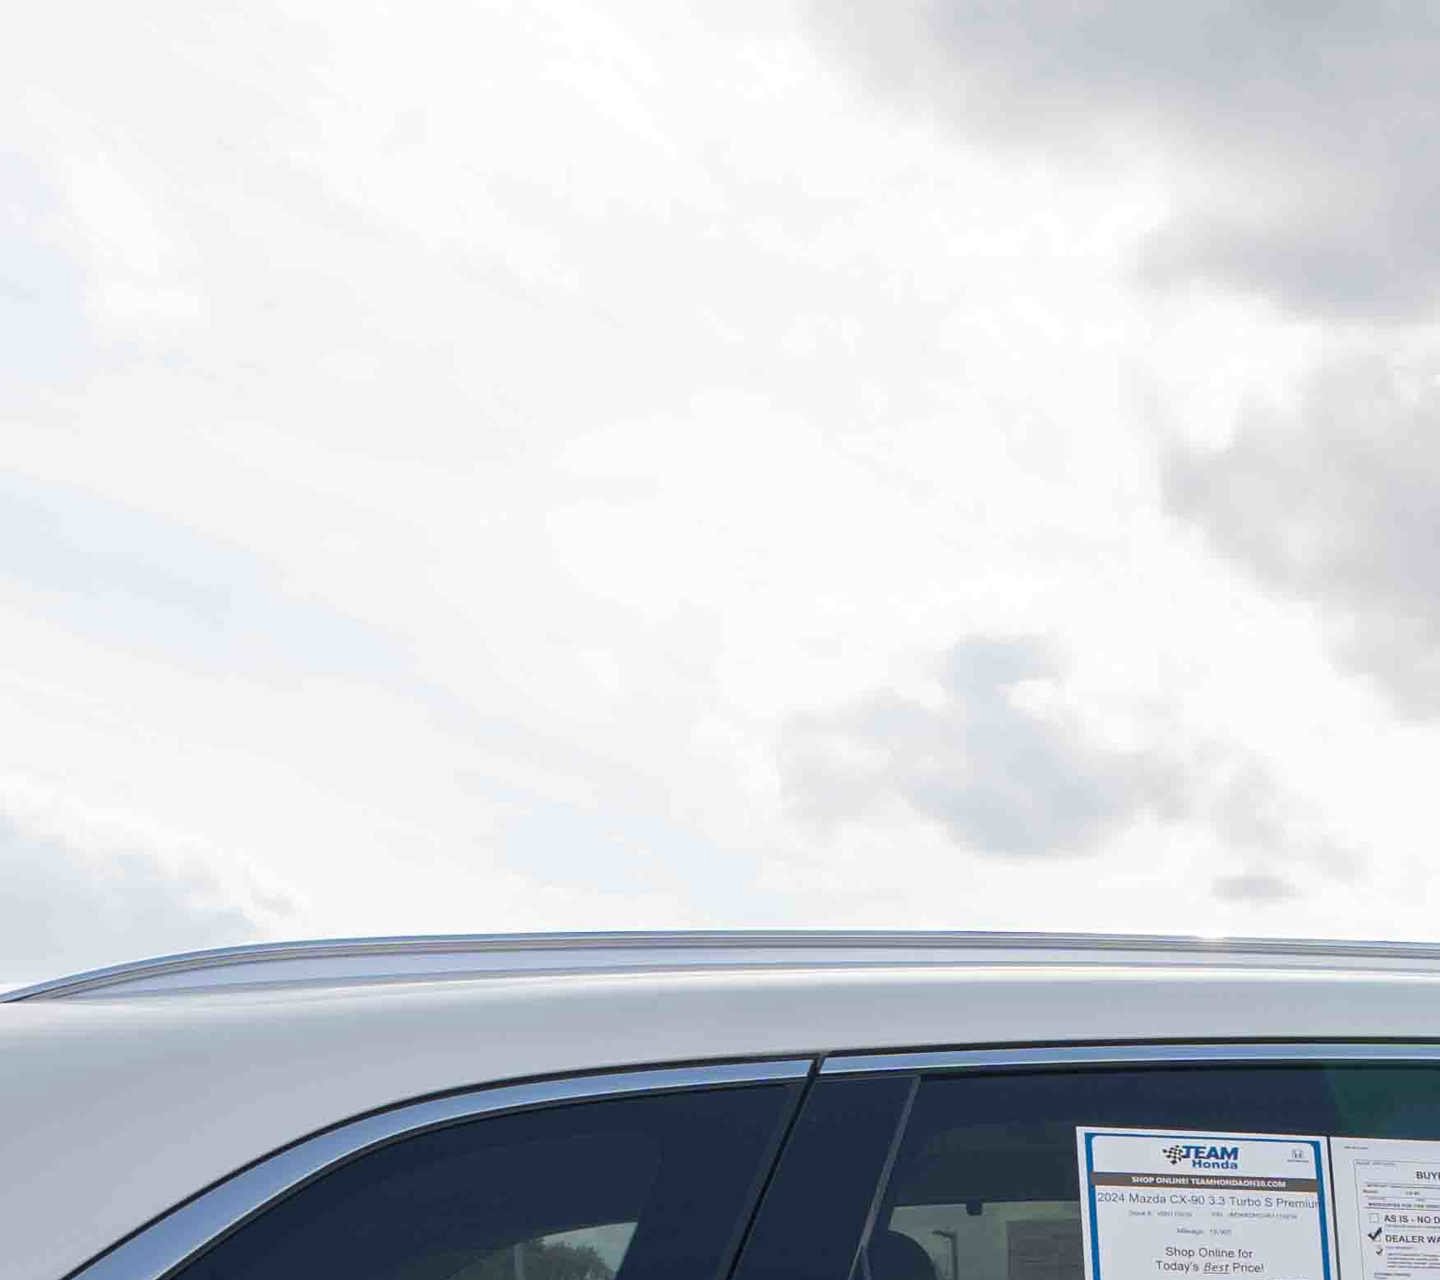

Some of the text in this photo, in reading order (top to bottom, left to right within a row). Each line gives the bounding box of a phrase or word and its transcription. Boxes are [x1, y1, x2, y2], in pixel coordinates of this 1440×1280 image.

[1182, 1145, 1239, 1160] TEAM
[1192, 1159, 1238, 1170] Honda
[1156, 1177, 1189, 1185] ONLINE!
[1097, 1192, 1125, 1202] 2024
[1129, 1193, 1166, 1204] Mazda
[1170, 1194, 1205, 1205] CX-90
[1208, 1196, 1225, 1206] 3.3
[1229, 1196, 1261, 1207] Turbo
[1264, 1197, 1273, 1208] S
[1384, 1214, 1398, 1223] AS
[1400, 1215, 1409, 1223] IS
[1417, 1215, 1432, 1224] NO
[1385, 1235, 1425, 1245] DEALER
[1165, 1247, 1253, 1258] Shop Online for
[1155, 1260, 1264, 1273] Today's Best Price!
